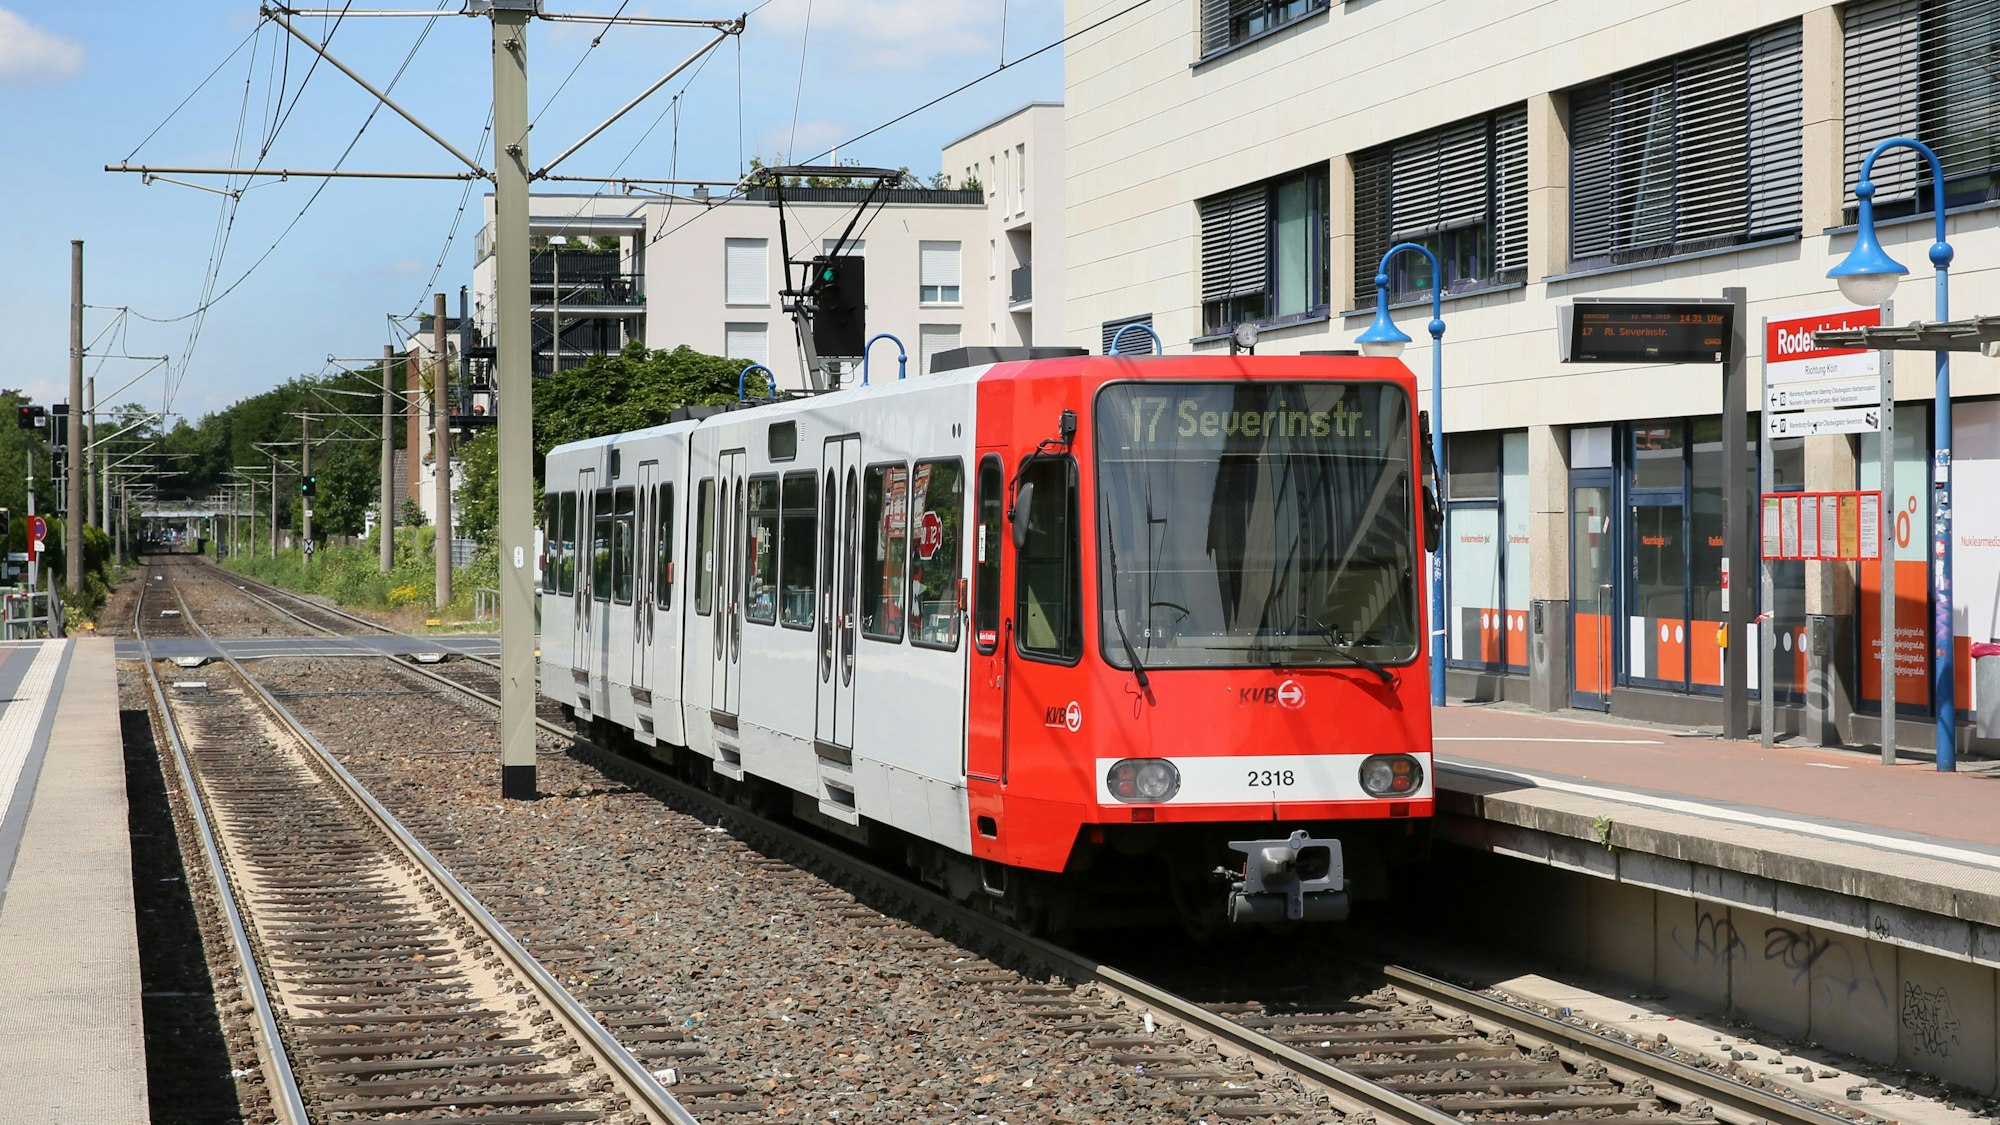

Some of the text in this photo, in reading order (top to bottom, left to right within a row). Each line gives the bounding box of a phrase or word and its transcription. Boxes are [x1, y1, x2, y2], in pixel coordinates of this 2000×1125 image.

[1707, 313, 1724, 323] Uhr
[1582, 327, 1593, 336] 17
[1619, 328, 1669, 337] Severinstr.
[1805, 364, 1838, 376] Richtung Köln
[1132, 396, 1372, 443] 17 Severinstr.
[1144, 628, 1162, 638] 6 1
[1239, 687, 1277, 704] KVB
[1046, 706, 1066, 723] KVB
[1247, 770, 1295, 787] 2318
